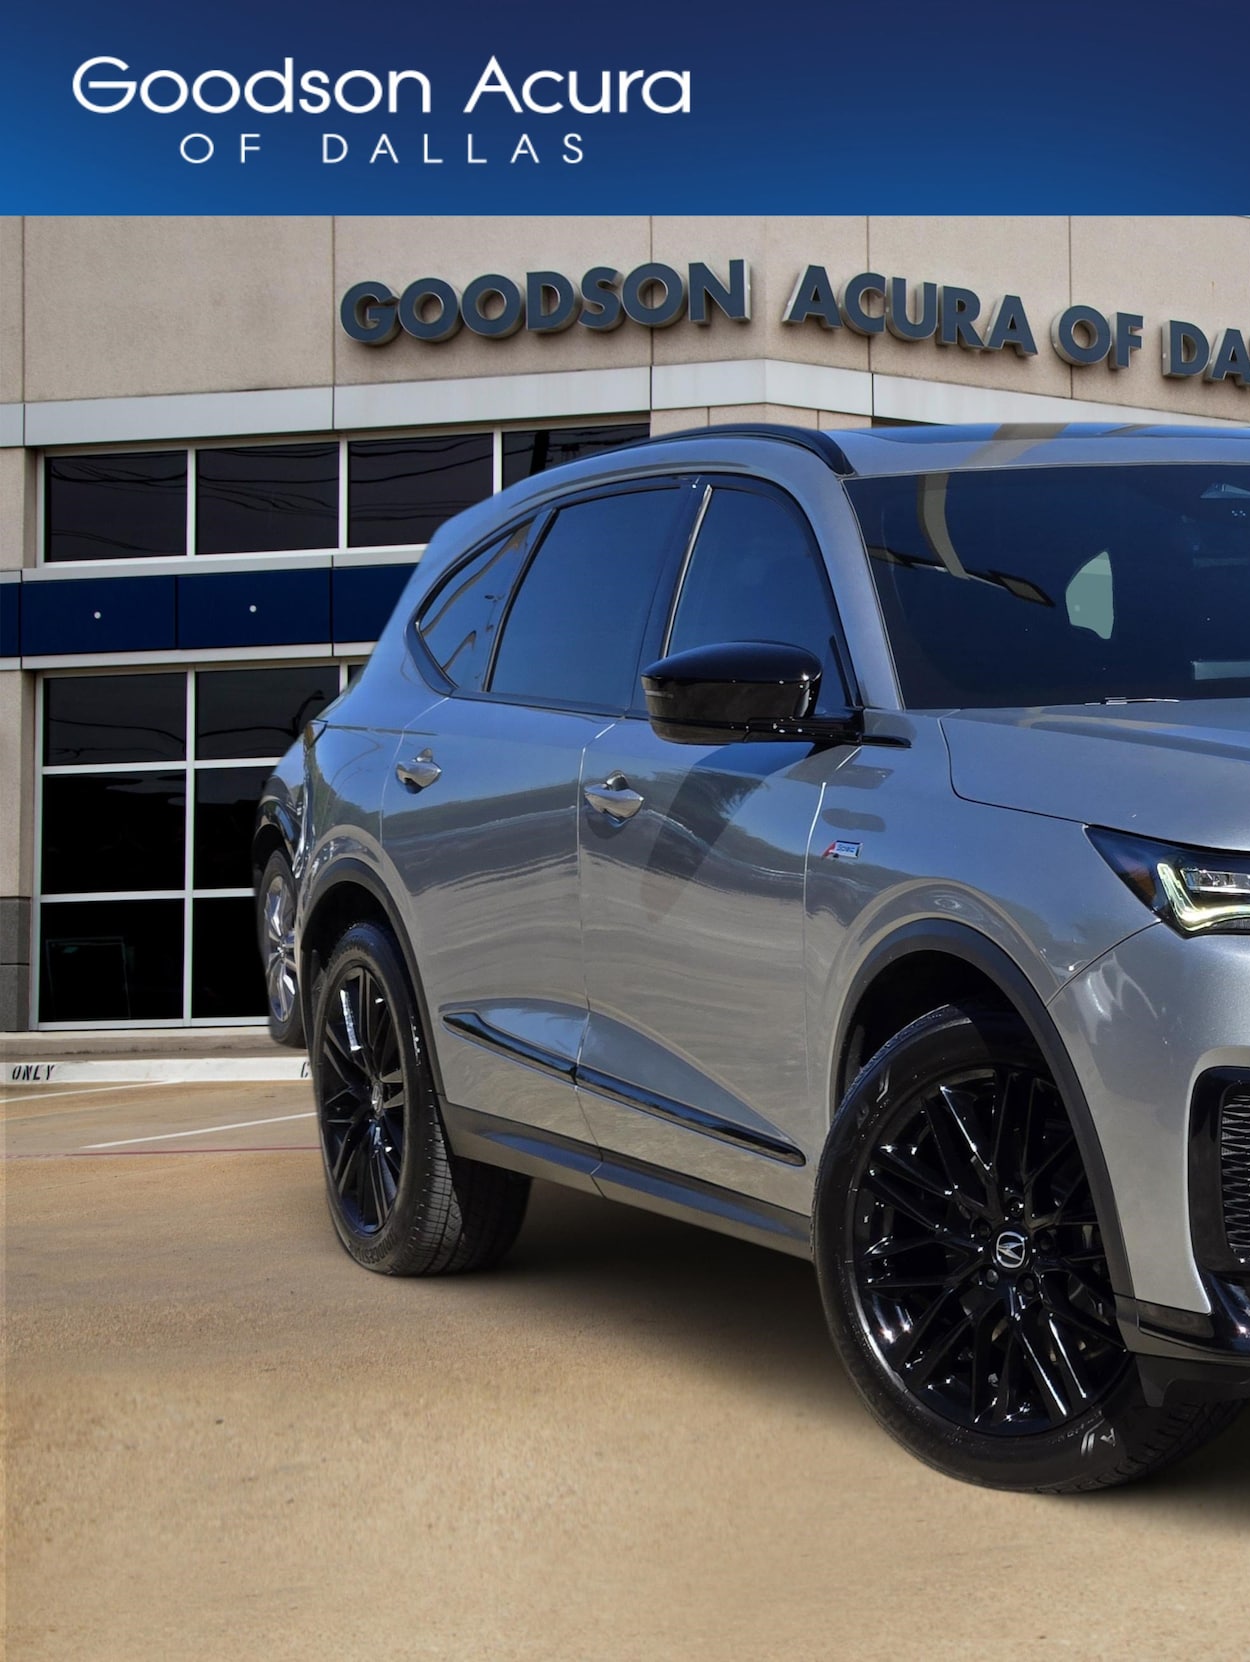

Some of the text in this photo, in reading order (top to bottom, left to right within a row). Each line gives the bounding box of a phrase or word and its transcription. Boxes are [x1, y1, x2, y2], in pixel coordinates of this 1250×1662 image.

[340, 259, 751, 346] GOODSON
[782, 263, 1038, 357] ACURA
[1051, 305, 1144, 370] OF
[12, 1064, 55, 1080] ONLY
